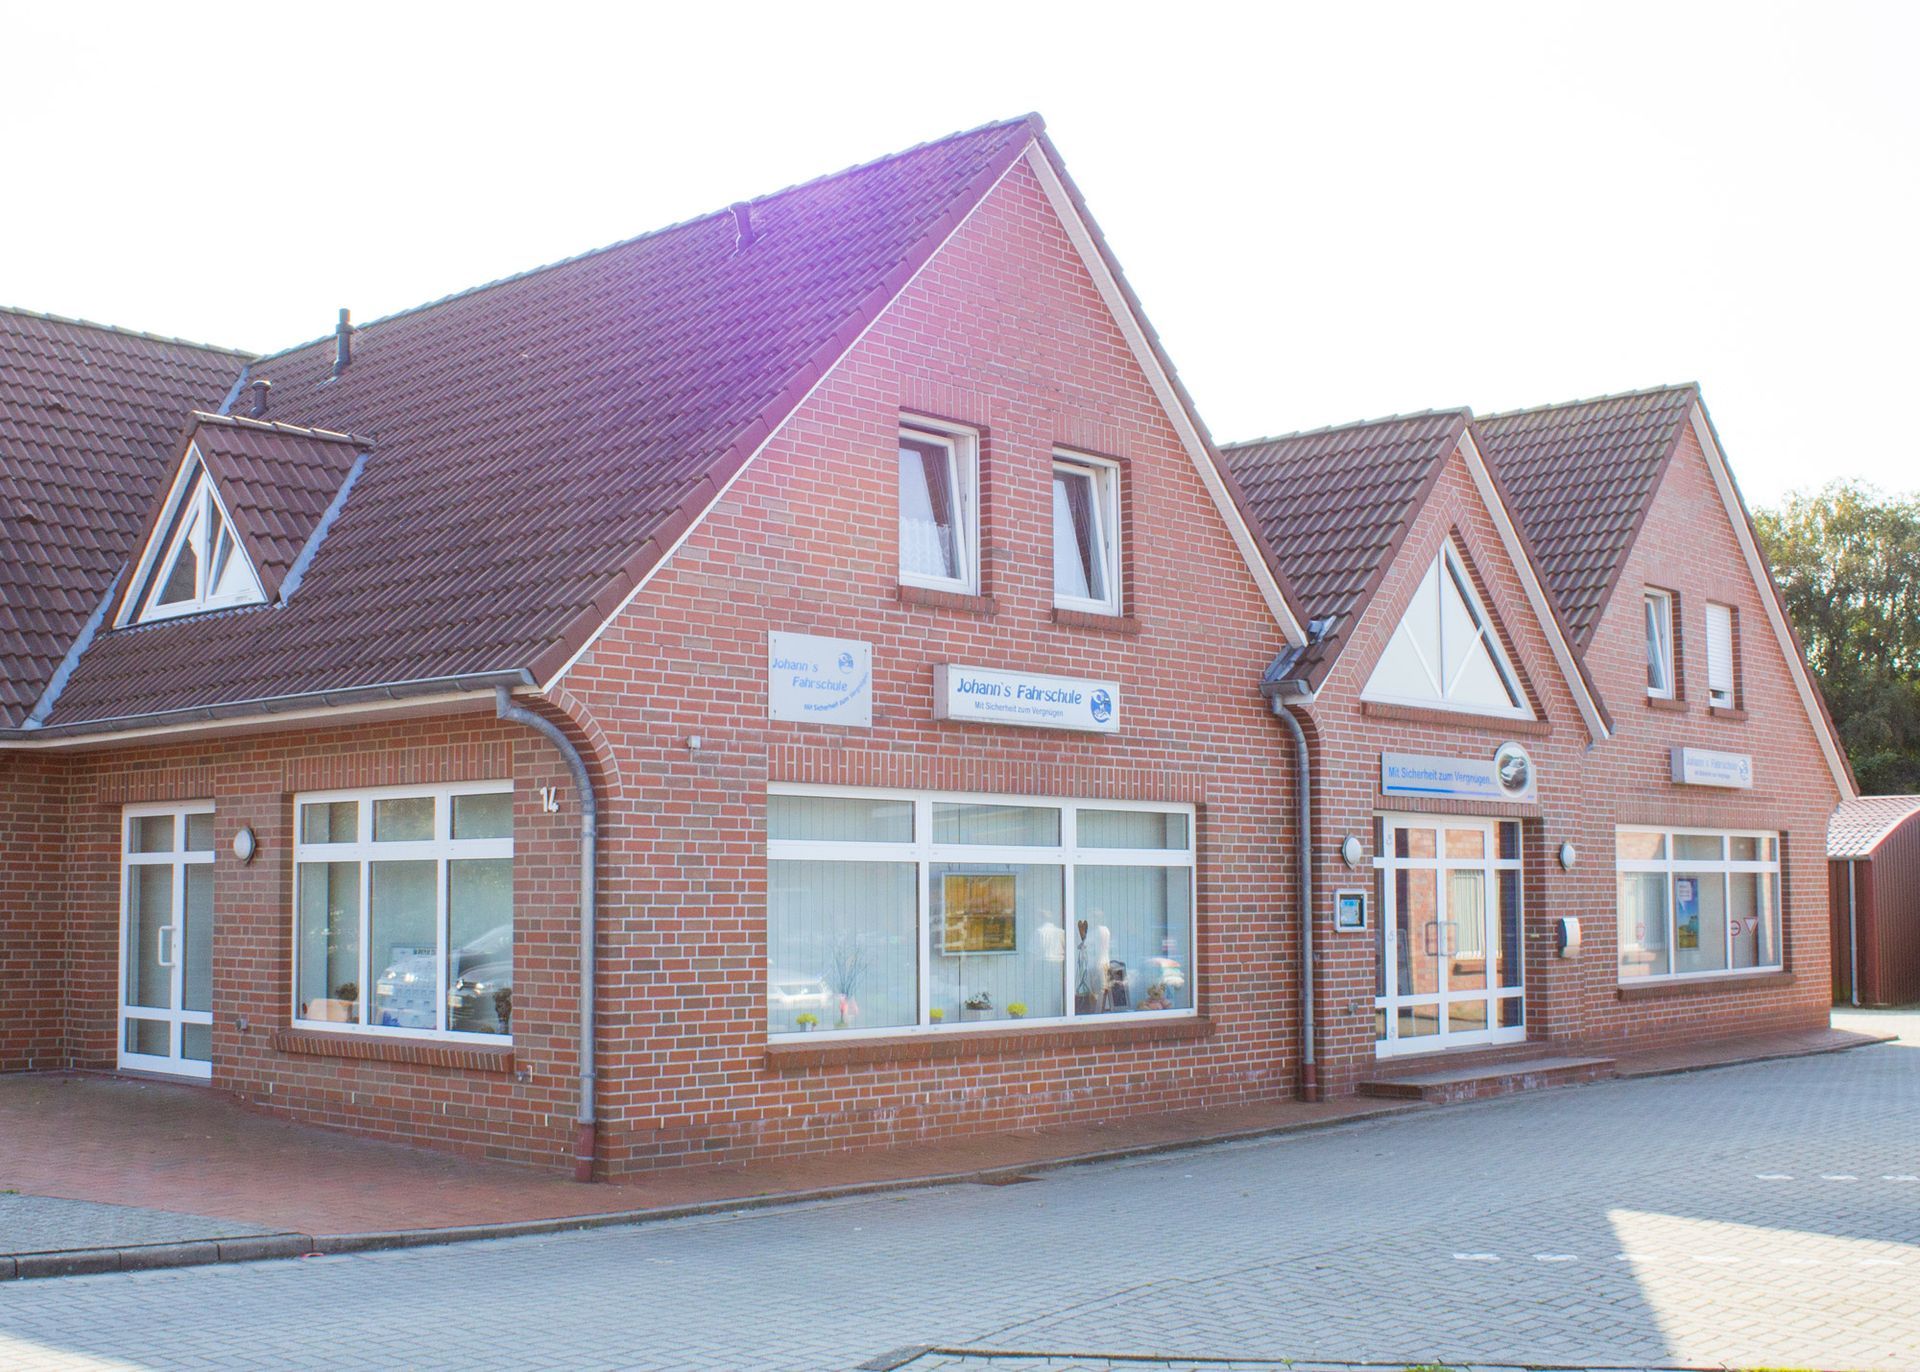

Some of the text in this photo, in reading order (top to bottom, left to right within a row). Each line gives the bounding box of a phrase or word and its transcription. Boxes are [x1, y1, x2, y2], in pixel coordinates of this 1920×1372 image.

[792, 676, 848, 692] Fahrschule
[1017, 684, 1082, 705] Fahrschule
[975, 701, 985, 710] Mit
[985, 702, 1017, 712] Sicherheit
[1018, 706, 1031, 714] zum
[1388, 766, 1400, 778] Mit
[1401, 767, 1437, 781] Sicherheit
[1439, 771, 1454, 782] zum
[540, 786, 559, 813] 14
